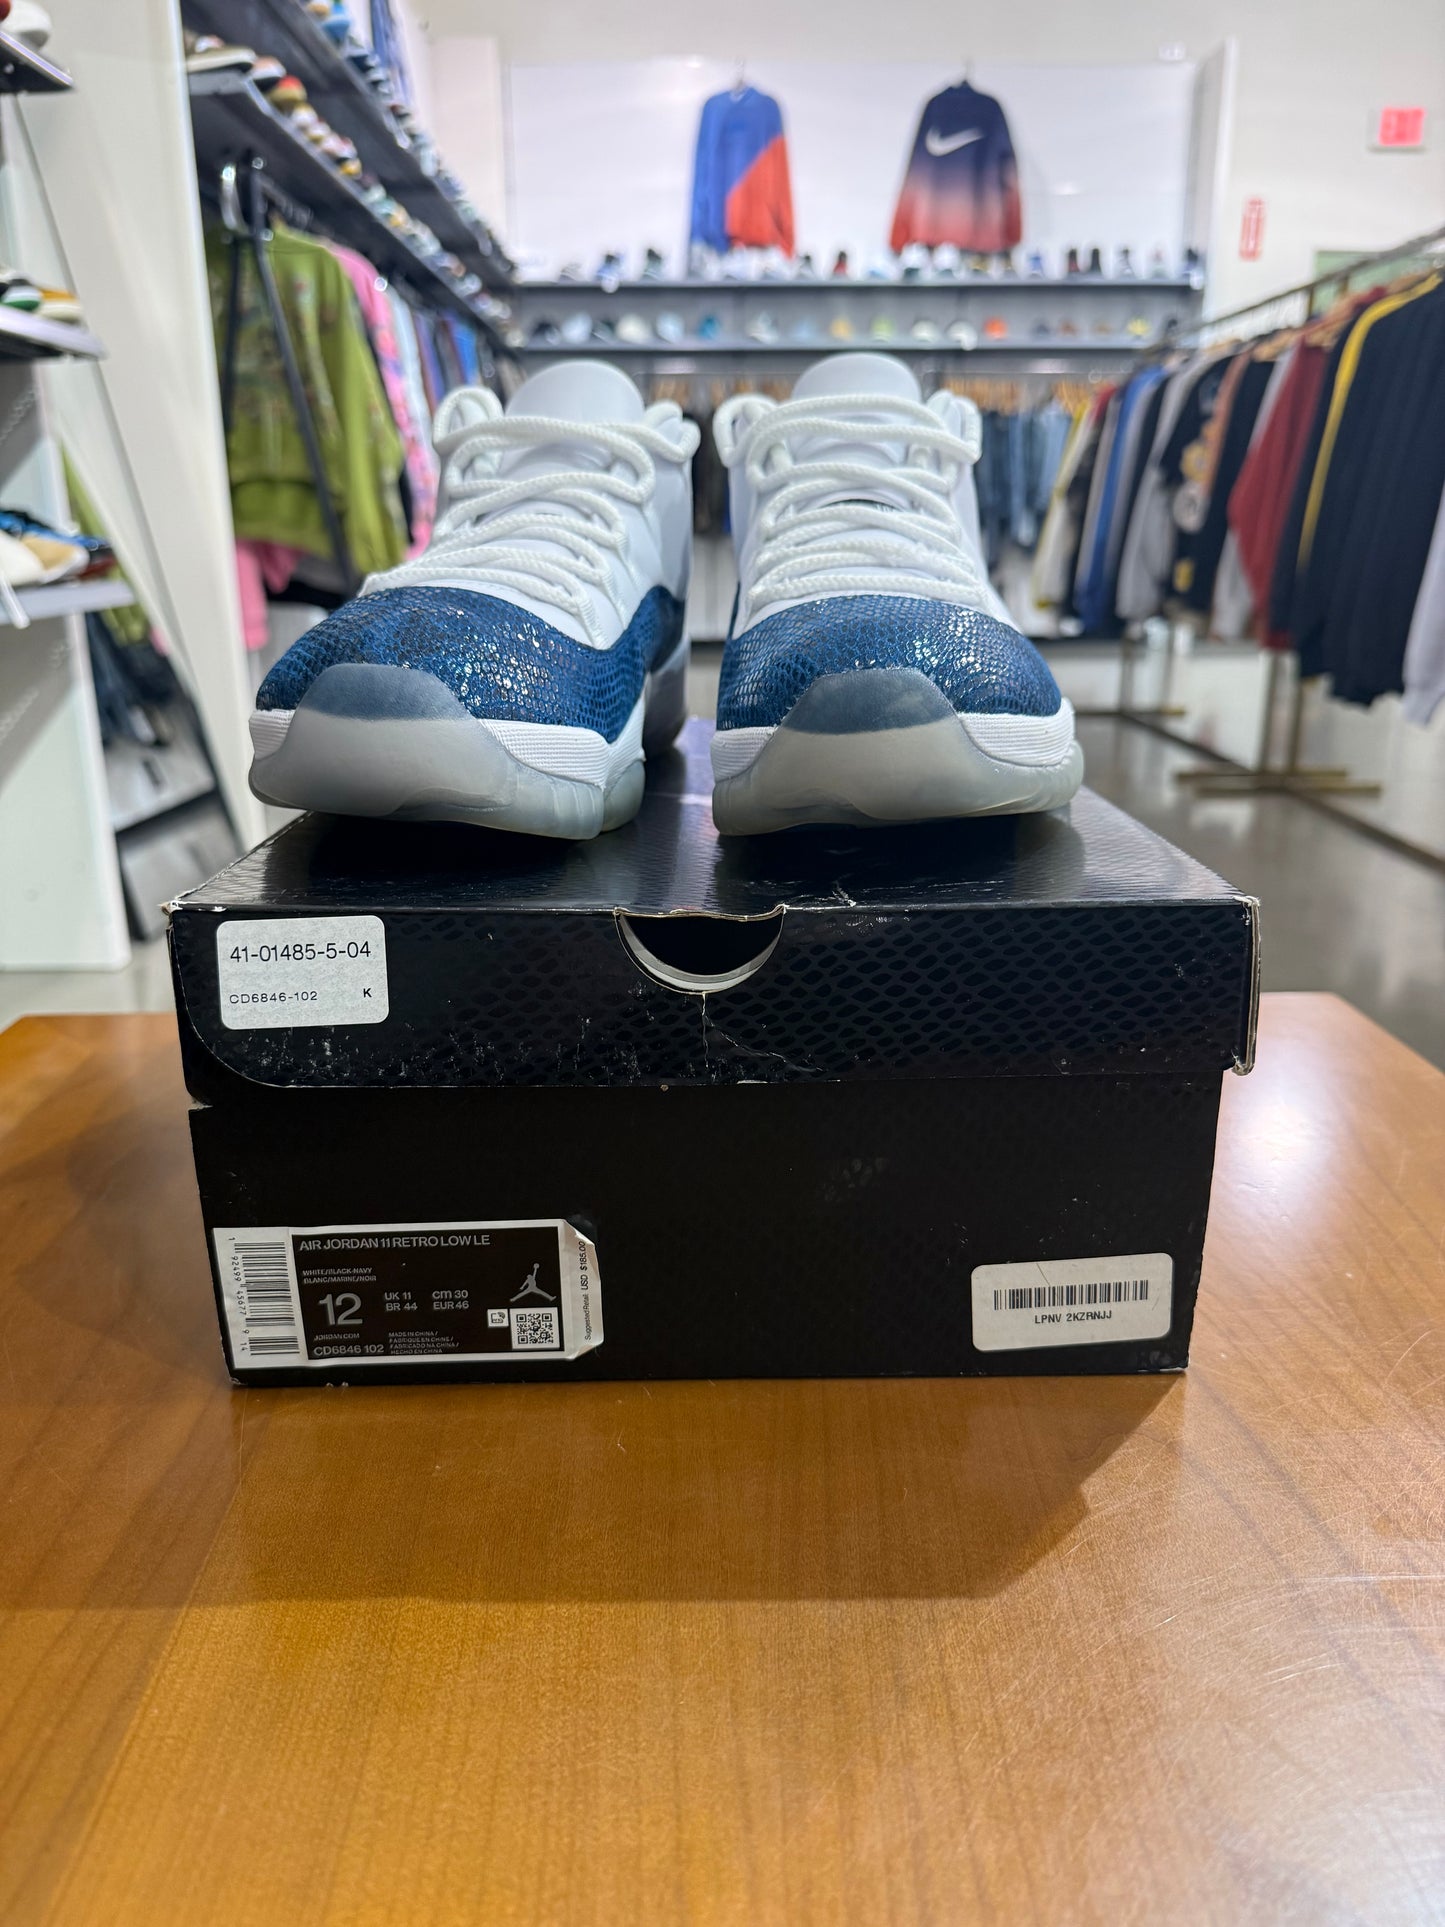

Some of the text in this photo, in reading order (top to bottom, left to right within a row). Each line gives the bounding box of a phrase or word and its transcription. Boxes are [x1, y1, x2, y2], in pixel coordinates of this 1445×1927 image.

[230, 941, 371, 963] 41-01485-5-04
[230, 991, 318, 1004] CD6846-102
[363, 988, 372, 998] K
[300, 1234, 491, 1251] AIR JORDAN 11 RETRO LOW LE
[579, 1240, 588, 1271] $185.00
[231, 1255, 242, 1282] 92499
[581, 1274, 589, 1290] USD
[384, 1291, 412, 1300] UK 11
[432, 1289, 469, 1299] cm 30
[236, 1290, 247, 1316] 45677
[318, 1292, 363, 1326] 12
[386, 1302, 418, 1311] BR 44
[433, 1300, 470, 1310] EUR 46
[1034, 1310, 1112, 1324] LPNV 2KZRNJJ
[584, 1311, 592, 1341] Suggested
[313, 1344, 385, 1356] CD6846 102
